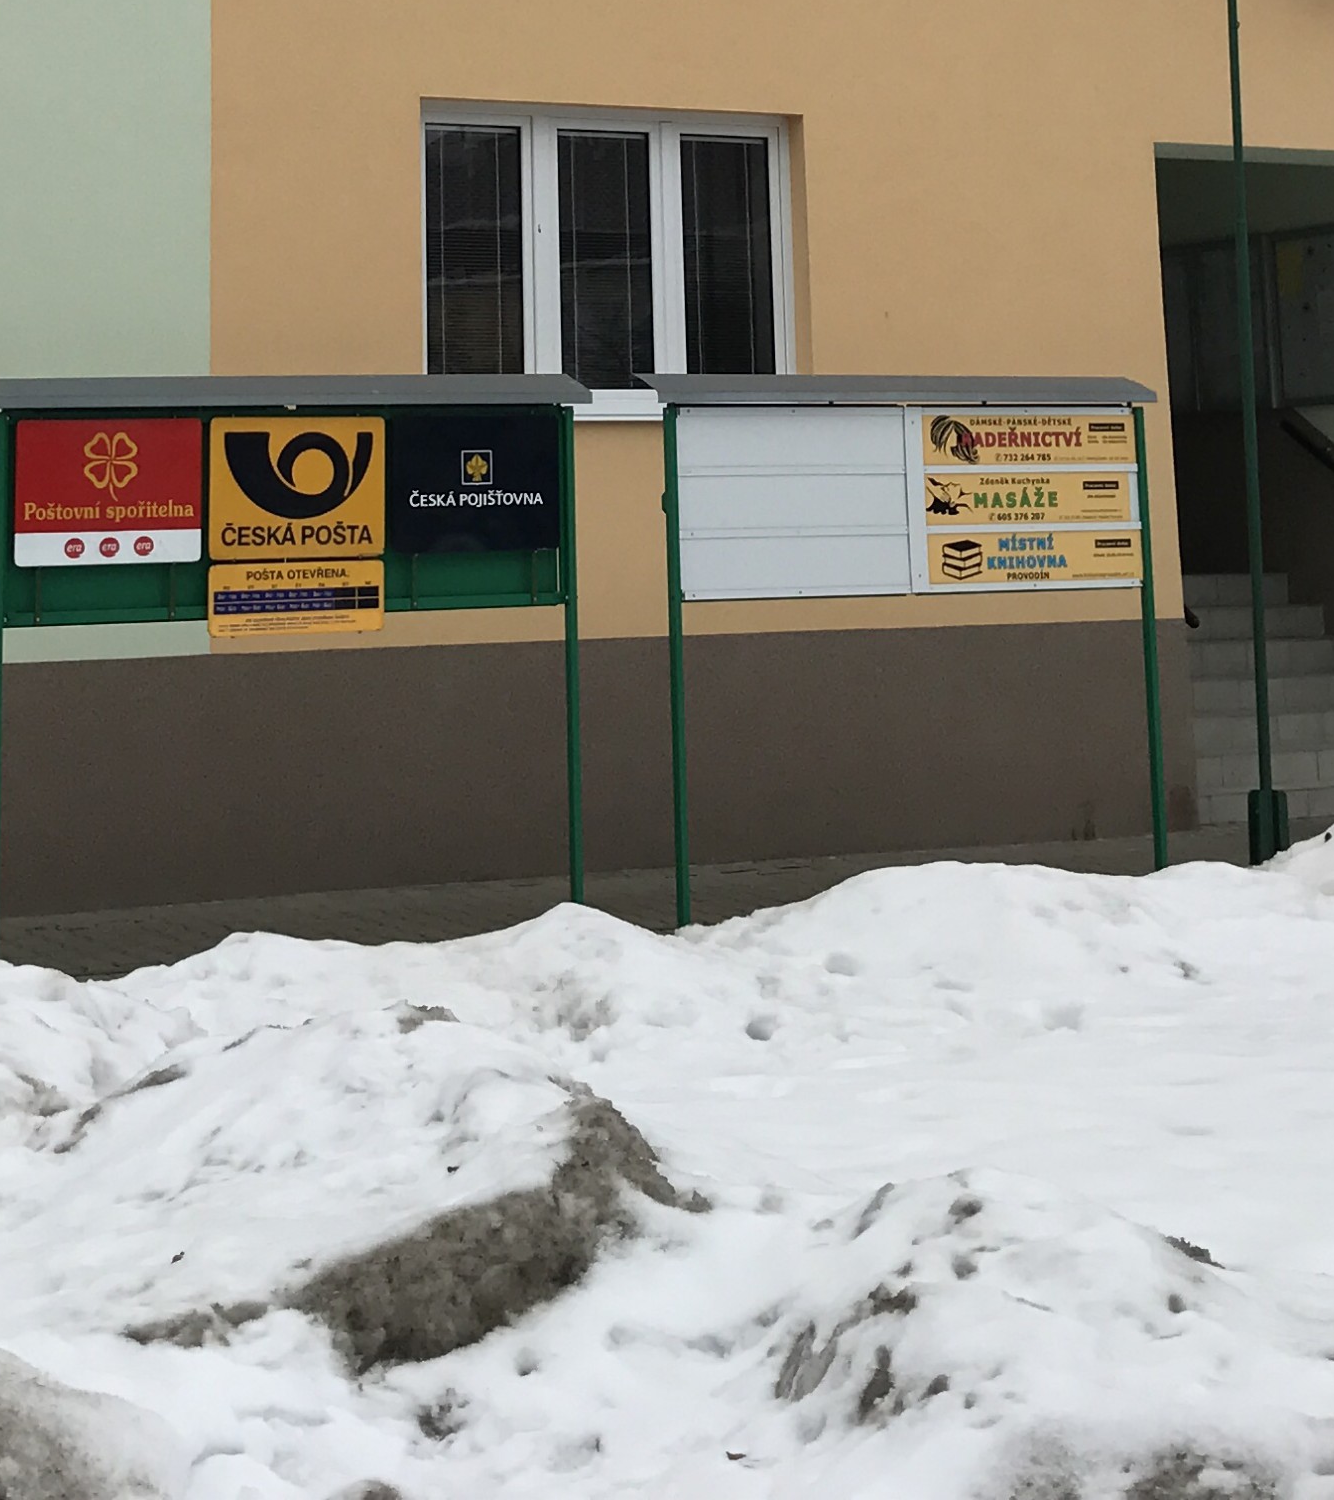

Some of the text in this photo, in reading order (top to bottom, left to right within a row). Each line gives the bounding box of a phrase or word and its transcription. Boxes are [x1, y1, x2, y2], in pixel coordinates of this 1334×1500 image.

[1003, 453, 1017, 462] 732
[1020, 453, 1035, 462] 264
[409, 489, 543, 508] ČESKÁ POJIŠŤOVNA
[973, 486, 1058, 509] MASÁŽE
[23, 499, 195, 522] Poštovní spořitelna
[221, 521, 373, 547] ČESKÁ POŠTA
[998, 533, 1055, 552] MÍSTNÍ
[986, 554, 1068, 570] KNIHOVNA
[246, 568, 284, 581] POŠTA
[1007, 569, 1050, 580] PROVODÍN
